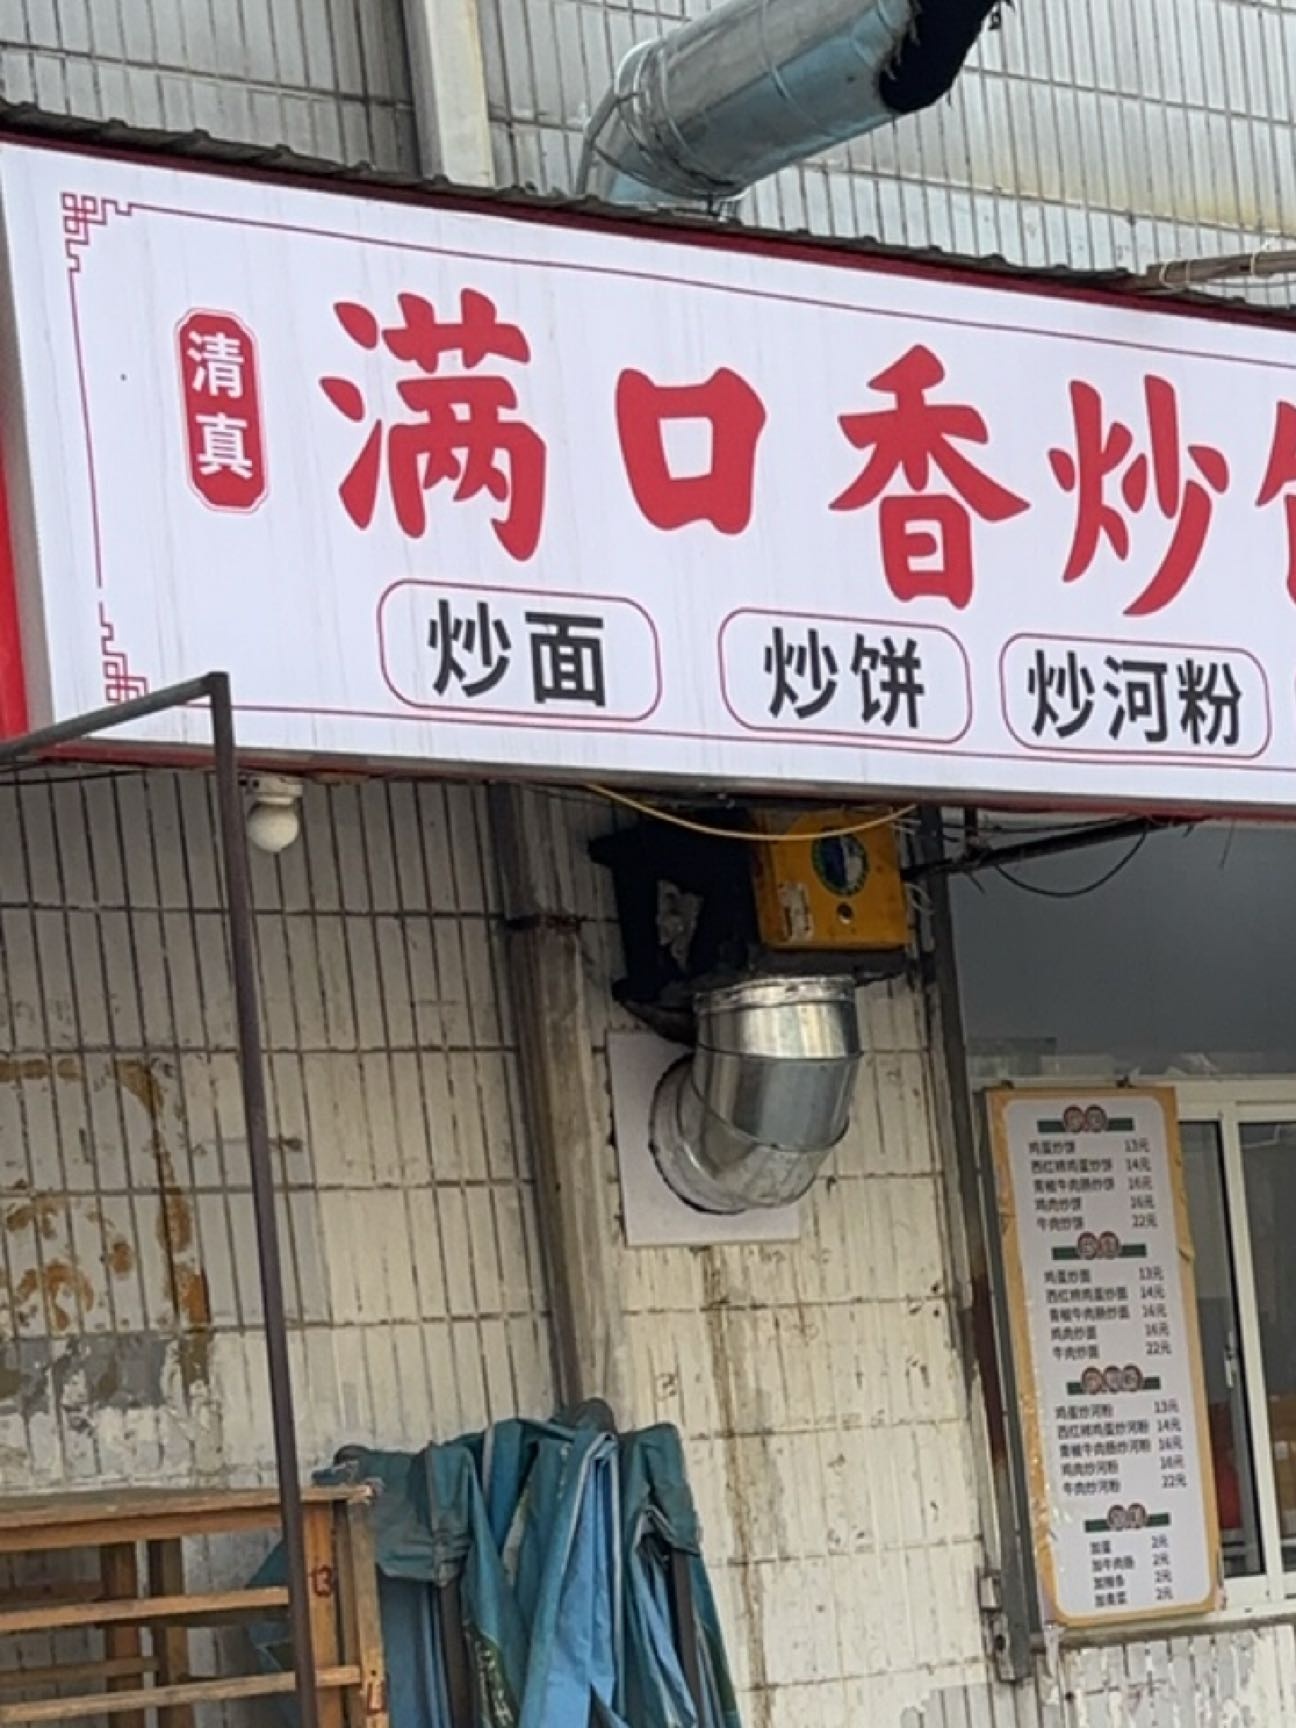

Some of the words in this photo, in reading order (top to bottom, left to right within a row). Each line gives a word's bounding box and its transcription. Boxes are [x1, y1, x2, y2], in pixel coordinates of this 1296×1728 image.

[188, 331, 252, 479] 清真
[427, 600, 607, 707] 炒面
[762, 626, 926, 729] 炒饼
[1026, 648, 1243, 747] 炒河粉
